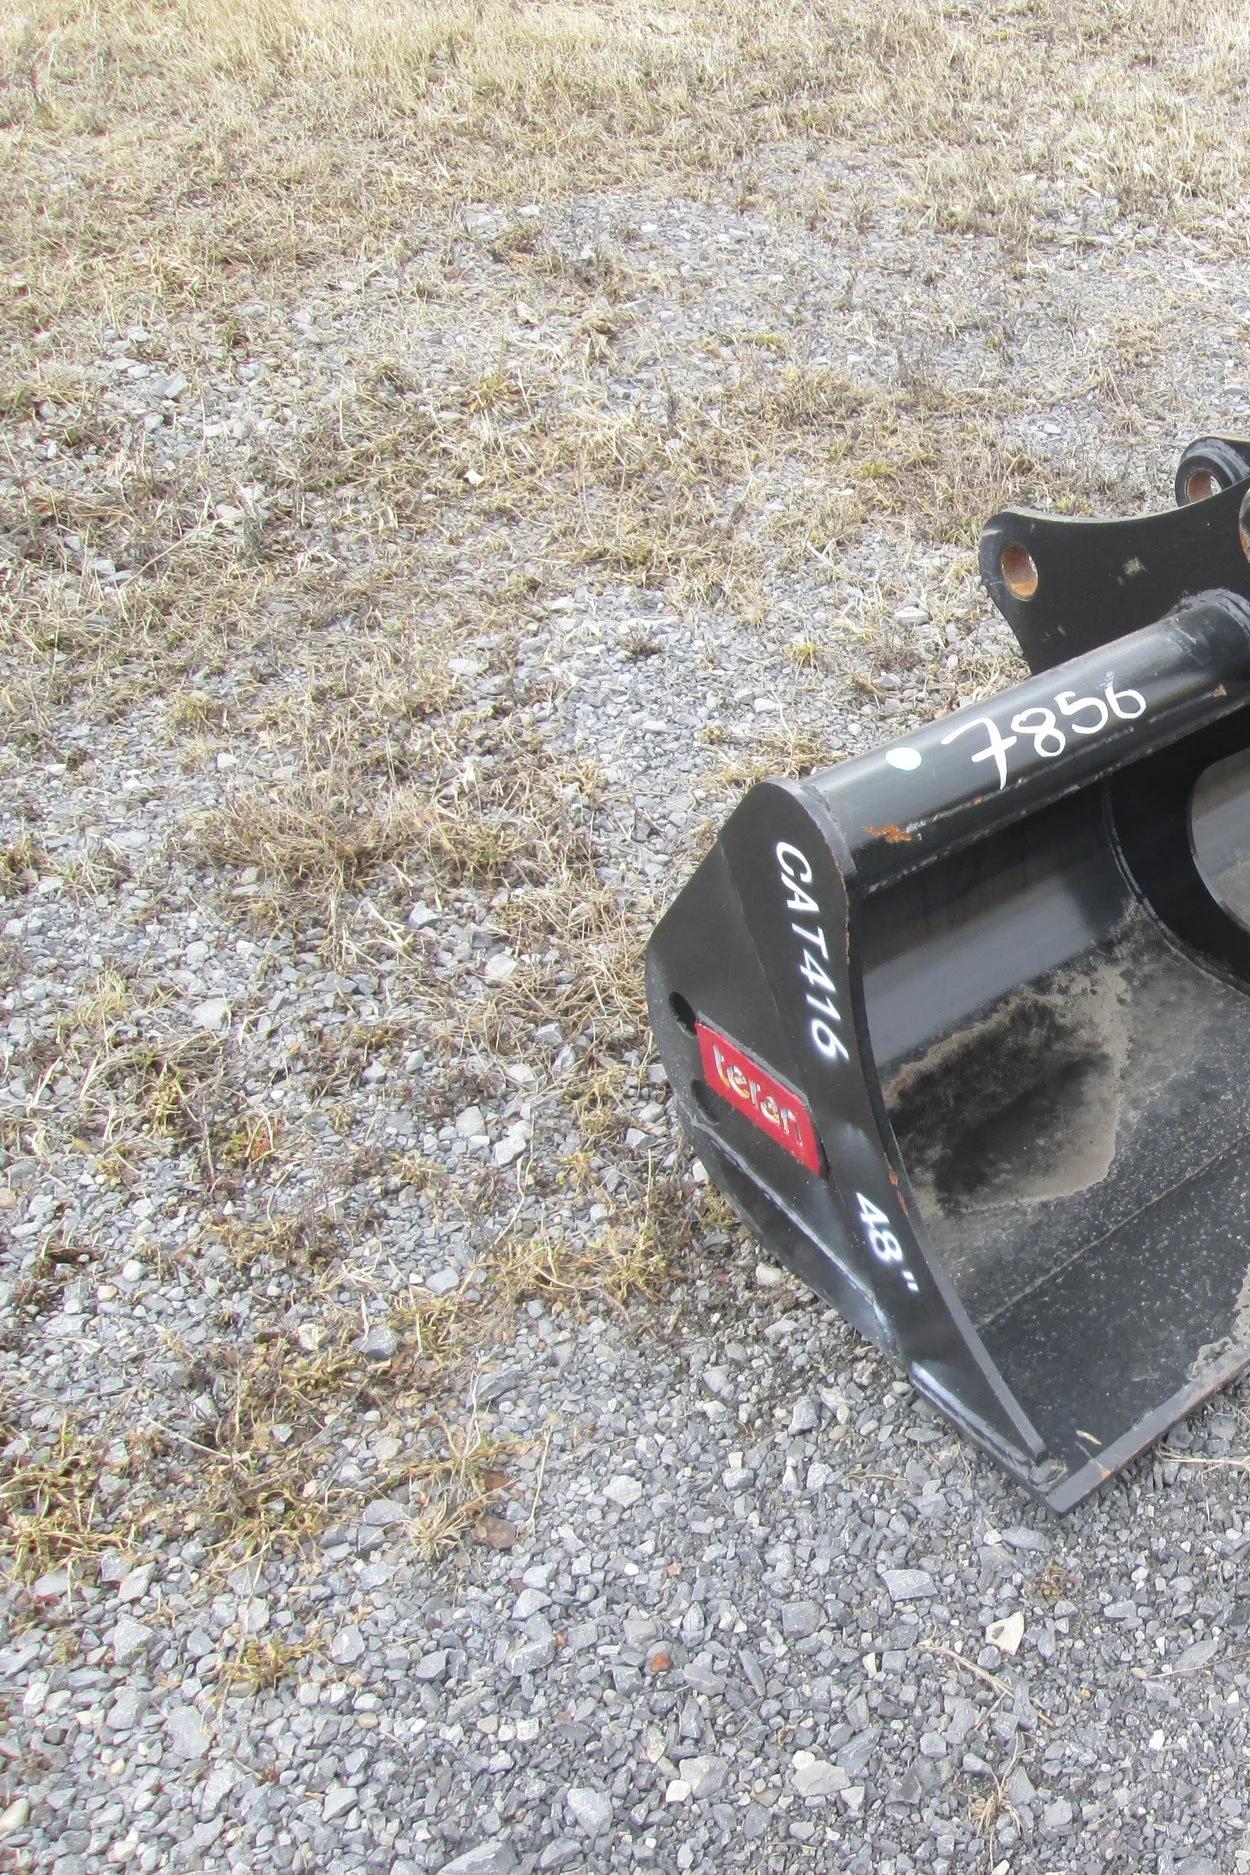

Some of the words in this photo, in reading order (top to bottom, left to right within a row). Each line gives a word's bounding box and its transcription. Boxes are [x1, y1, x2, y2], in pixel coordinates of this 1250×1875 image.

[940, 672, 1147, 791] 7856
[775, 840, 850, 1063] CAT416
[855, 1191, 920, 1293] 48"
